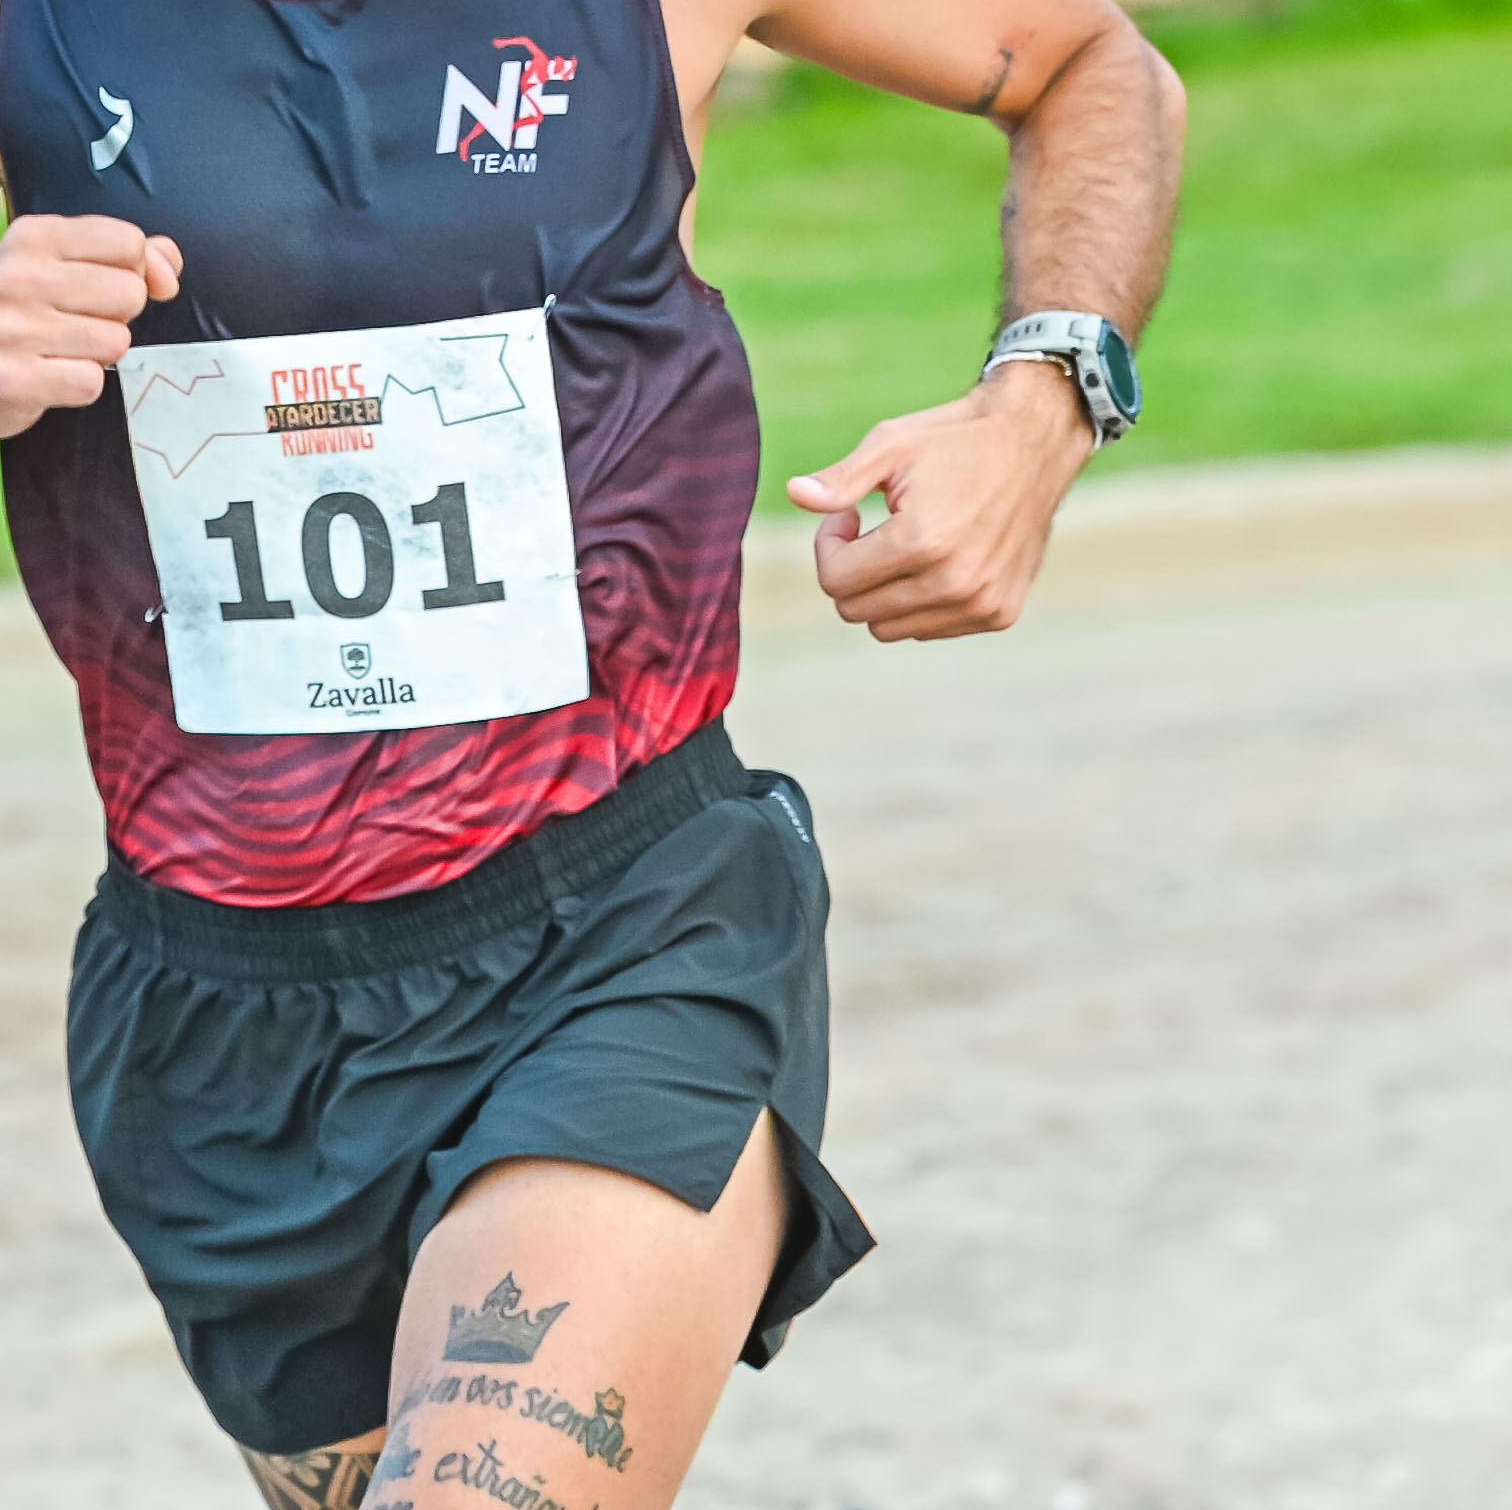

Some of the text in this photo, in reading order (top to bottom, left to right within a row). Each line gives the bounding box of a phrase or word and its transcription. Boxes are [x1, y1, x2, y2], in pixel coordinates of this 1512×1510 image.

[436, 59, 577, 154] NF
[470, 153, 538, 174] TEAM
[271, 363, 366, 405] CROSS
[266, 399, 381, 432] ATARDECER
[204, 482, 505, 622] 101
[306, 678, 416, 709] Zavalla
